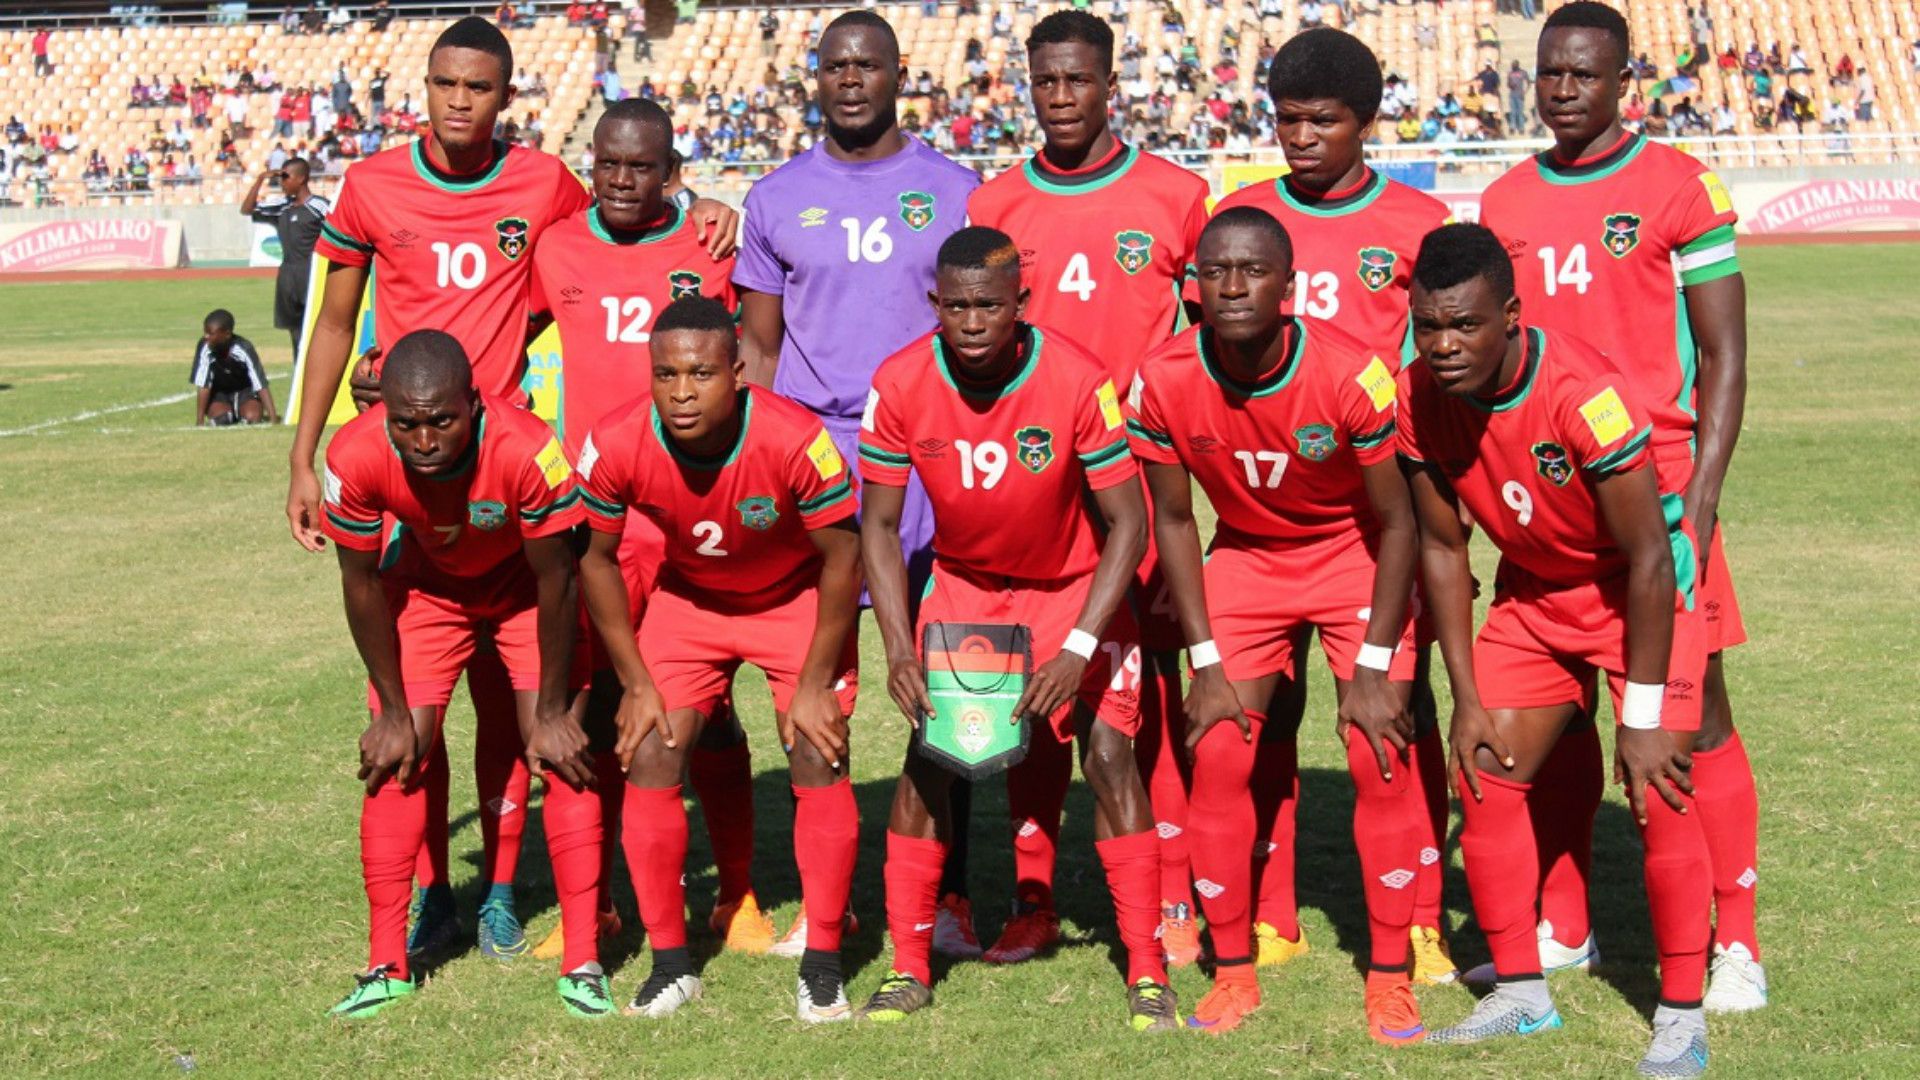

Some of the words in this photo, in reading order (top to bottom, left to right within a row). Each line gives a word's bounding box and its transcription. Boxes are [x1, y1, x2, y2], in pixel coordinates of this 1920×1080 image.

[1762, 179, 1920, 231] KILIMANJARO
[1803, 206, 1853, 227] PREMIUM
[1856, 204, 1891, 216] LAGER
[1, 220, 151, 268] KILIMANJARO
[840, 216, 893, 263] 16
[431, 241, 487, 290] 10
[1058, 252, 1097, 301] 4
[1537, 243, 1593, 296] 14
[600, 296, 652, 343] 12
[1294, 271, 1340, 320] 13
[954, 439, 1008, 490] 19
[1234, 450, 1289, 488] 17
[1502, 480, 1533, 527] 9
[433, 524, 461, 544] 7
[692, 520, 728, 556] 2
[1101, 641, 1141, 691] 19
